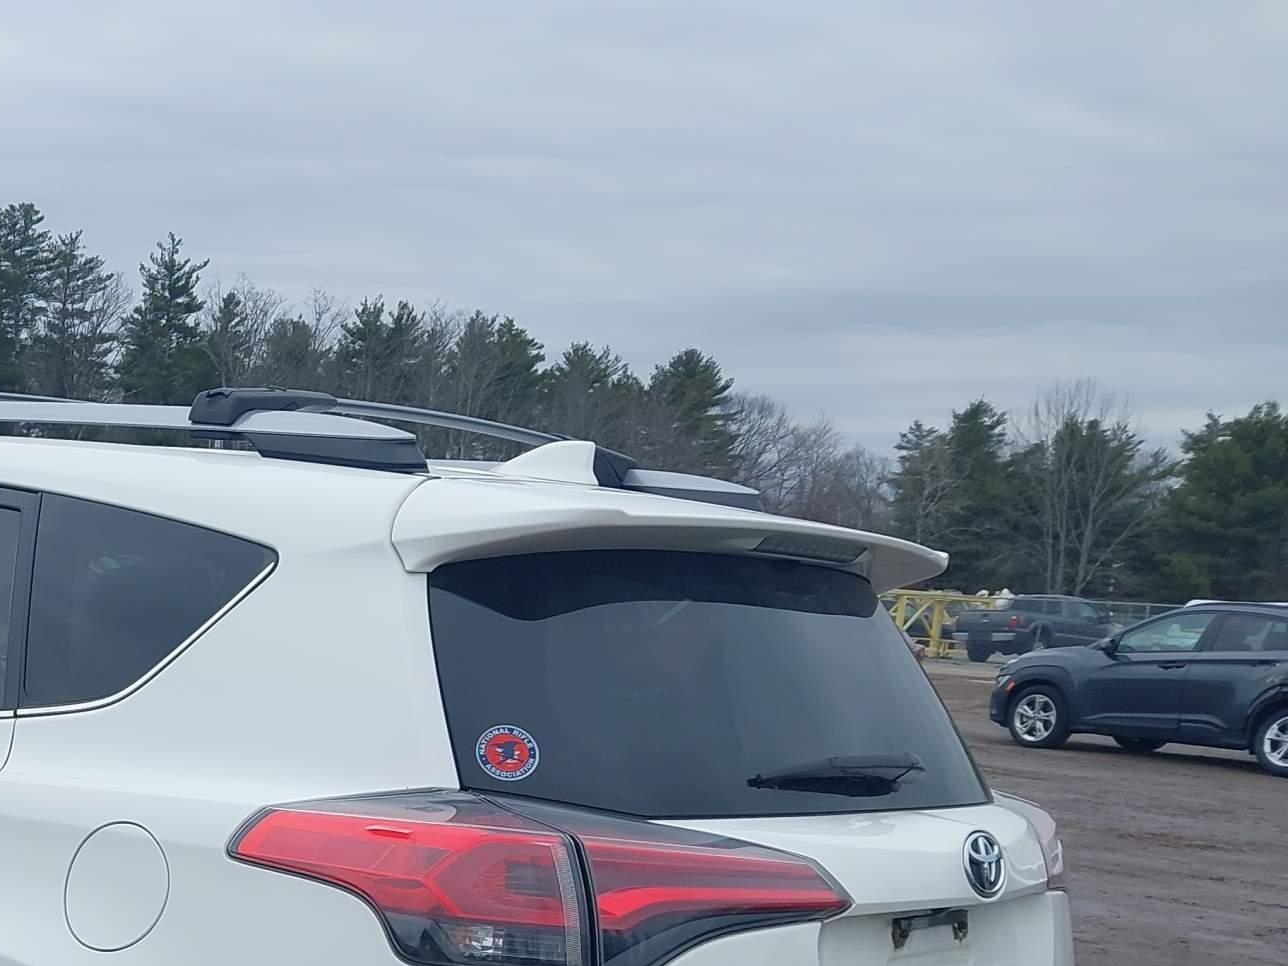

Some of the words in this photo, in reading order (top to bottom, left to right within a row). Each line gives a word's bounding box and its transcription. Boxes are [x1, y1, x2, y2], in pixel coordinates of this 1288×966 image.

[479, 728, 510, 755] NATIONAL
[512, 729, 533, 749] RIFLE
[485, 758, 535, 778] ASSOCIATION
